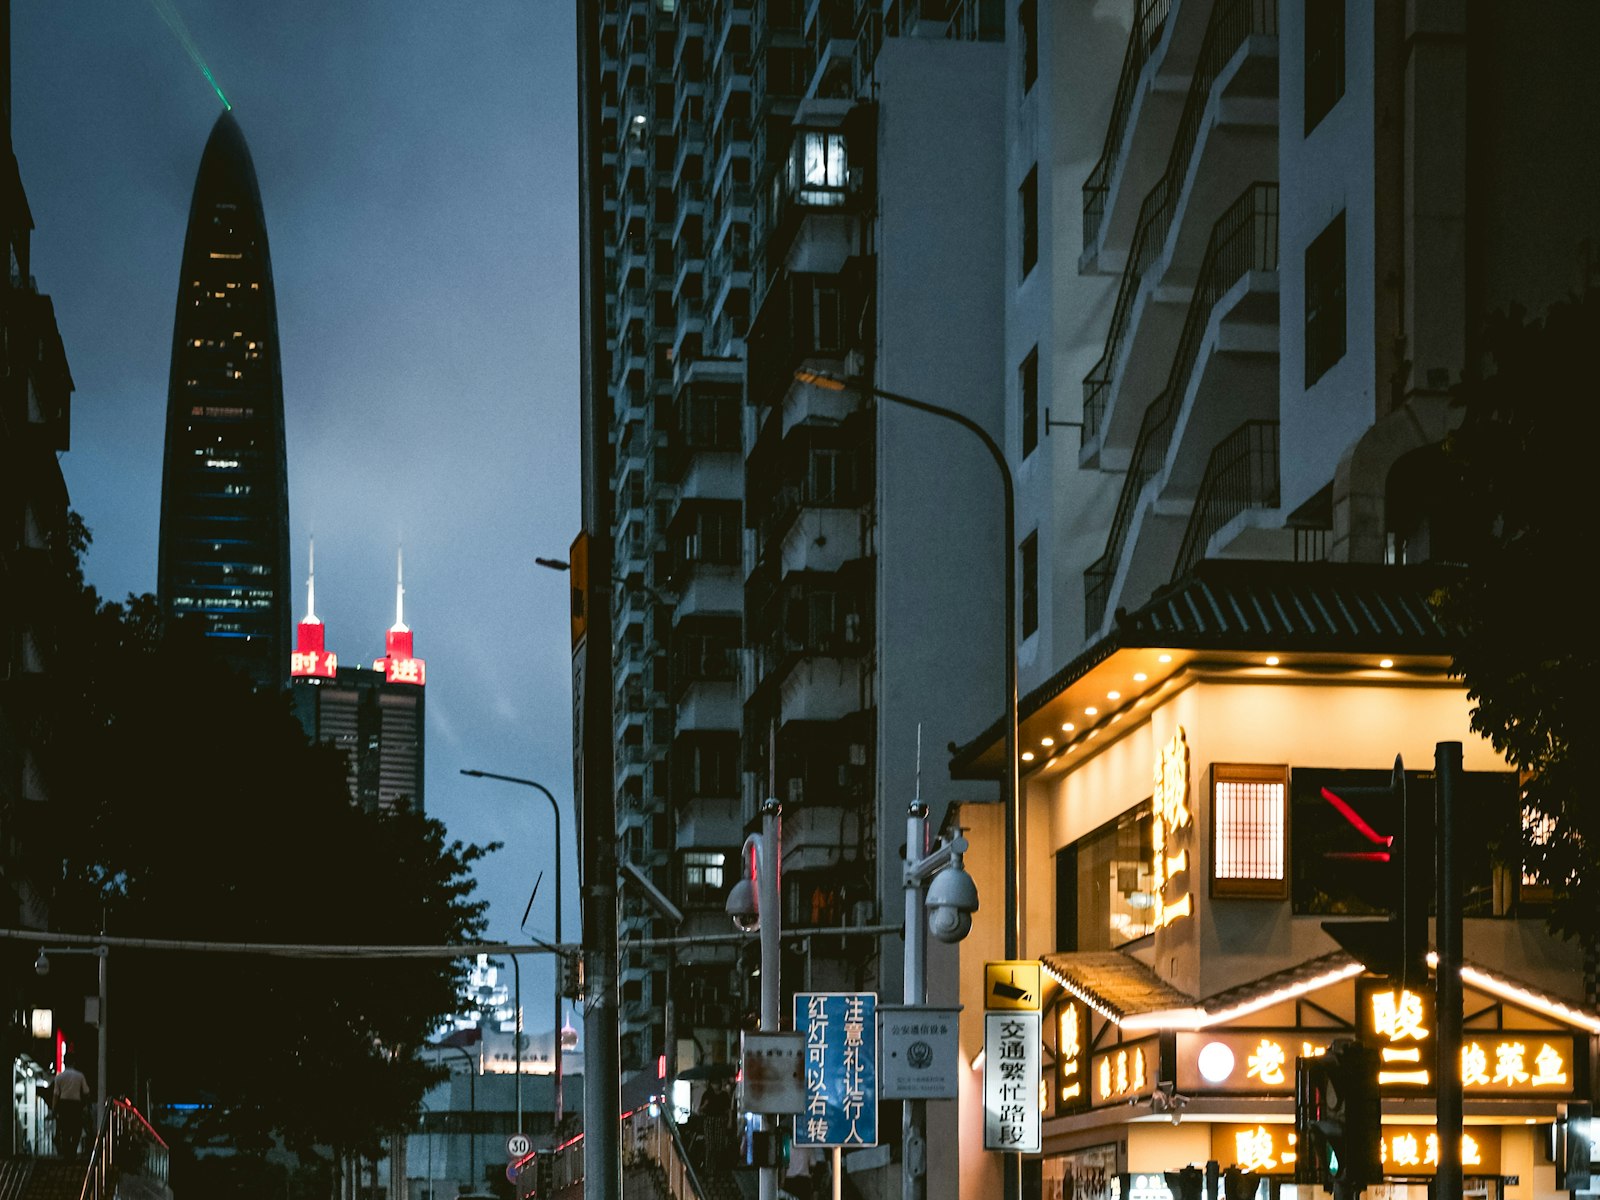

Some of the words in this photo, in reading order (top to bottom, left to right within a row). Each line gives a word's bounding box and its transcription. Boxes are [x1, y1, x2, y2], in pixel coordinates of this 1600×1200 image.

[808, 996, 828, 1143] 红灯可以右转
[843, 996, 864, 1144] 注意礼让行人
[999, 1020, 1026, 1145] 交通繁忙路段
[1372, 989, 1430, 1085] 酸二
[1461, 1042, 1567, 1087] 酸菜鱼
[512, 1140, 526, 1152] 30
[1380, 1133, 1480, 1167] 酸菜鱼
